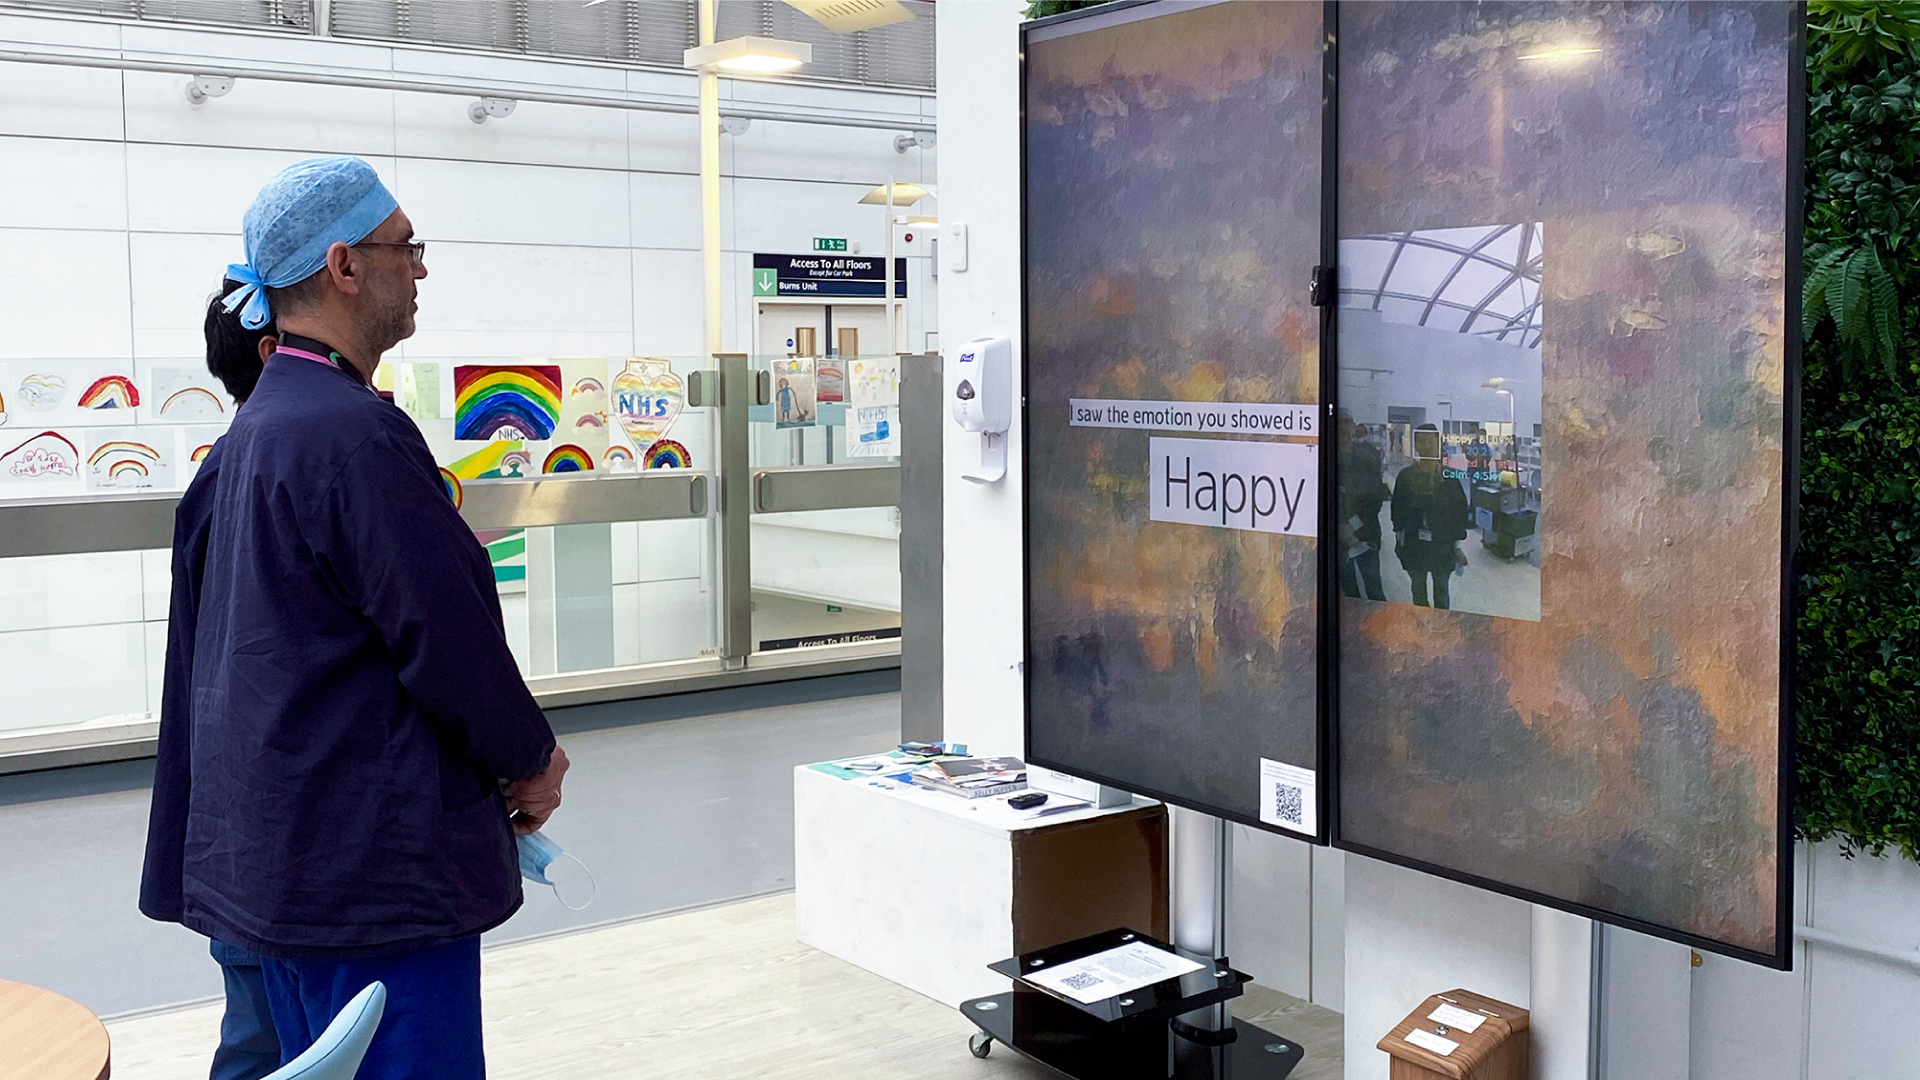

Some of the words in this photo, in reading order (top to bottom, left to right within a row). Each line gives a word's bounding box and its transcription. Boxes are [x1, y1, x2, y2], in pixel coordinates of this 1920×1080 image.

[790, 259, 819, 269] Access
[820, 259, 831, 269] To
[833, 259, 845, 269] All
[846, 260, 872, 270] Floors
[779, 282, 800, 291] Burns
[802, 282, 818, 291] Unit
[619, 394, 669, 417] NHS
[1070, 404, 1073, 421] I
[1077, 408, 1102, 422] saw
[1107, 406, 1129, 424] the
[1133, 406, 1192, 427] emotion
[1197, 412, 1226, 431] you
[1231, 410, 1293, 431] showed
[1298, 411, 1312, 431] is
[1166, 455, 1306, 532] Happy
